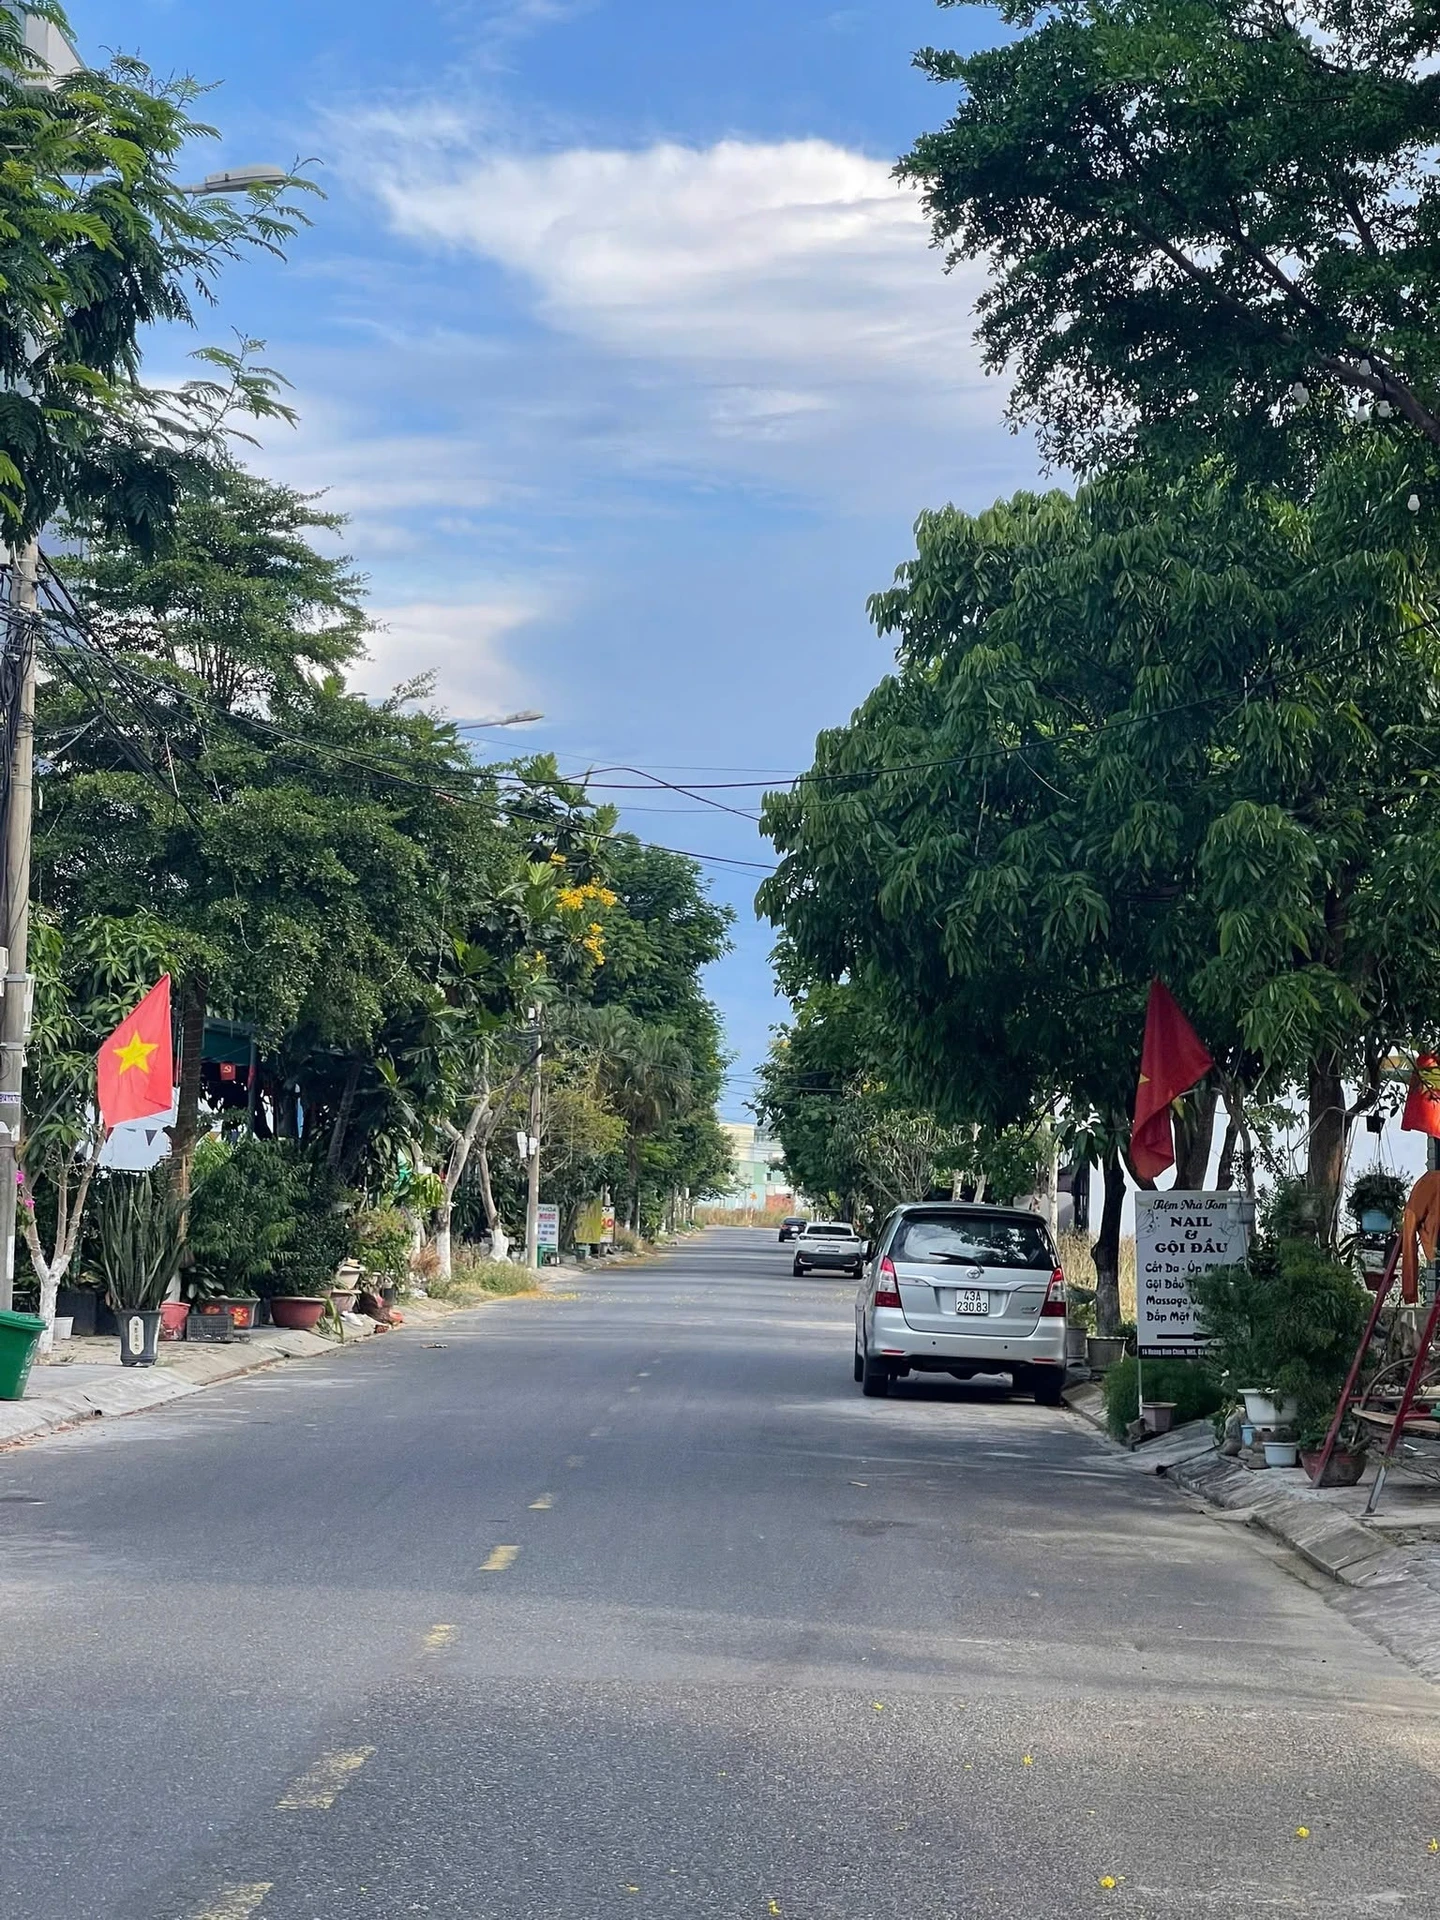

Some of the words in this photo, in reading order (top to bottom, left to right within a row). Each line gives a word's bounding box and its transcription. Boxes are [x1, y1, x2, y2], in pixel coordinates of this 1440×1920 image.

[1180, 1199, 1203, 1210] Nhà
[1204, 1199, 1228, 1210] Tom
[1170, 1216, 1212, 1228] NAIL
[1184, 1230, 1198, 1240] &
[1155, 1240, 1186, 1256] GỘI
[1190, 1237, 1228, 1253] ĐẦU
[1145, 1261, 1162, 1273] Cắt
[1165, 1263, 1179, 1273] Da
[1187, 1260, 1202, 1276] Úp
[1146, 1279, 1162, 1292] Gội
[963, 1291, 981, 1301] 43A
[1146, 1296, 1188, 1308] Massage
[957, 1302, 988, 1312] 230.83
[1170, 1312, 1190, 1325] Mặt
